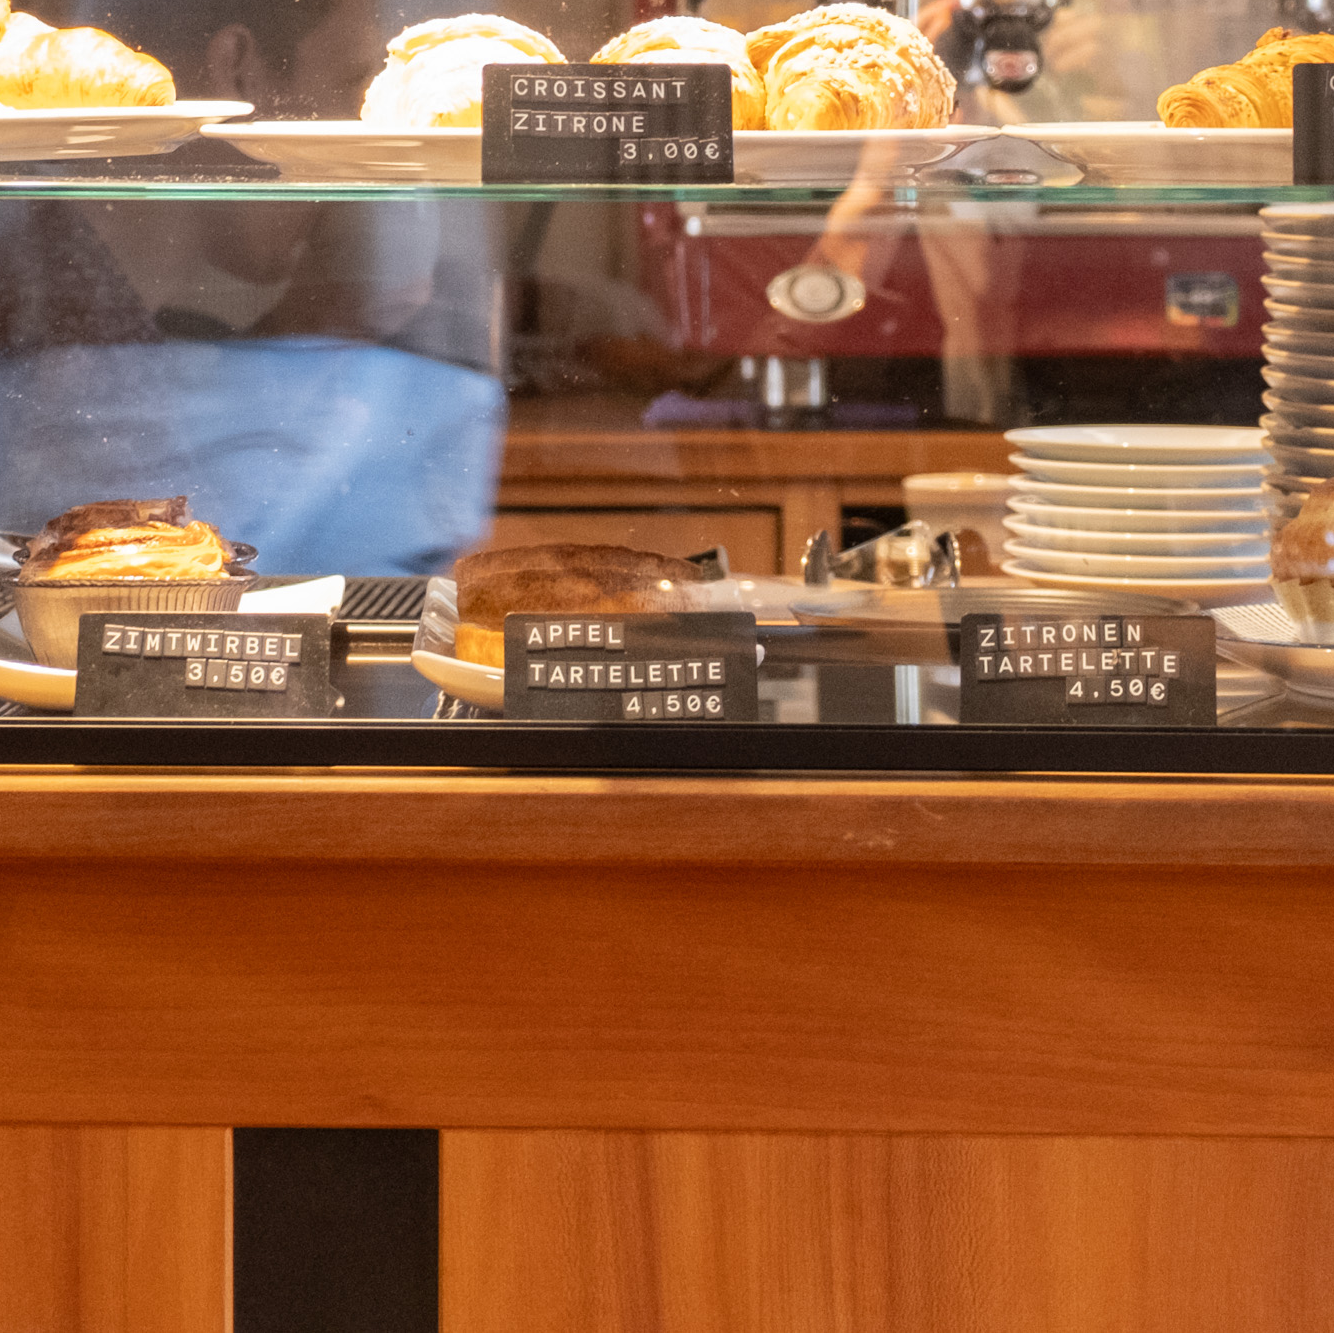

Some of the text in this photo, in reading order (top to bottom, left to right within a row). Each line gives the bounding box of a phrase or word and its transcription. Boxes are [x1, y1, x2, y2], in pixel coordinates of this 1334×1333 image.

[513, 78, 687, 100] CROISSANT
[513, 112, 646, 134] ZITRONE
[623, 141, 721, 162] 3,00€
[104, 629, 301, 659] ZIMTWIRBEL
[526, 622, 623, 648] APFEL
[980, 621, 1142, 647] ZITRONEN
[187, 661, 287, 687] 3,50€
[528, 660, 725, 684] TARTELETTE
[977, 649, 1178, 676] TARTELETTE
[1068, 677, 1167, 703] 4,50€
[625, 694, 723, 718] 4,50€
